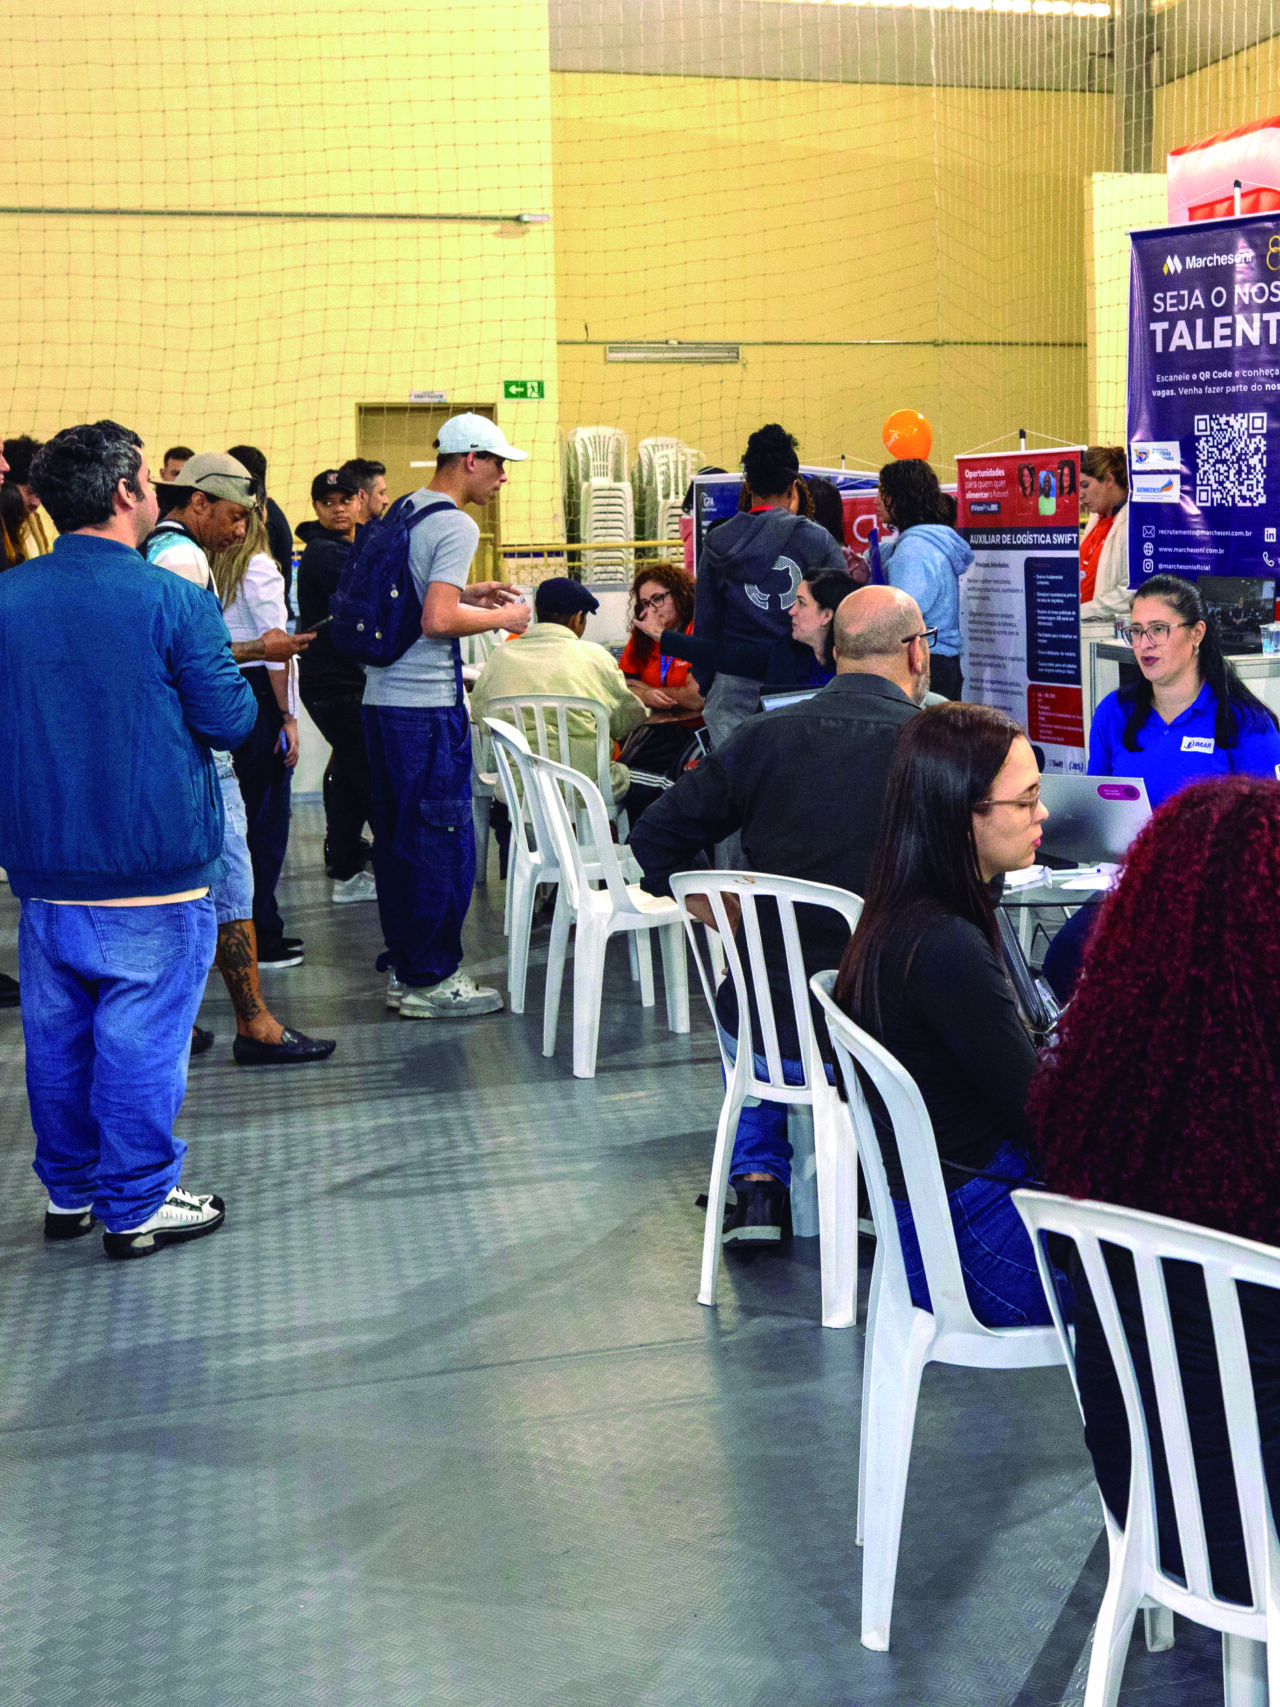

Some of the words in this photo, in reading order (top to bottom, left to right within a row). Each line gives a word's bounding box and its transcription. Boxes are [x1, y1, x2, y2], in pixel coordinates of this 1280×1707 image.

[1185, 253, 1252, 270] Marchesoni
[1153, 289, 1205, 313] SEJA
[1211, 287, 1227, 308] O
[1156, 373, 1190, 383] Escaneie
[1199, 371, 1211, 381] QR
[1212, 369, 1233, 379] Code
[1242, 367, 1279, 378] conheça
[1152, 389, 1176, 398] vagas.
[1178, 386, 1202, 395] Venha
[1204, 385, 1224, 394] fazer
[1226, 384, 1248, 395] parte
[1250, 382, 1263, 392] do
[964, 468, 1005, 479] Oportunidades
[965, 481, 977, 489] para
[970, 533, 1001, 544] AUXILIAR
[1001, 533, 1012, 544] DE
[1012, 531, 1052, 545] LOGÍSTICA
[1053, 533, 1078, 544] SWIFT
